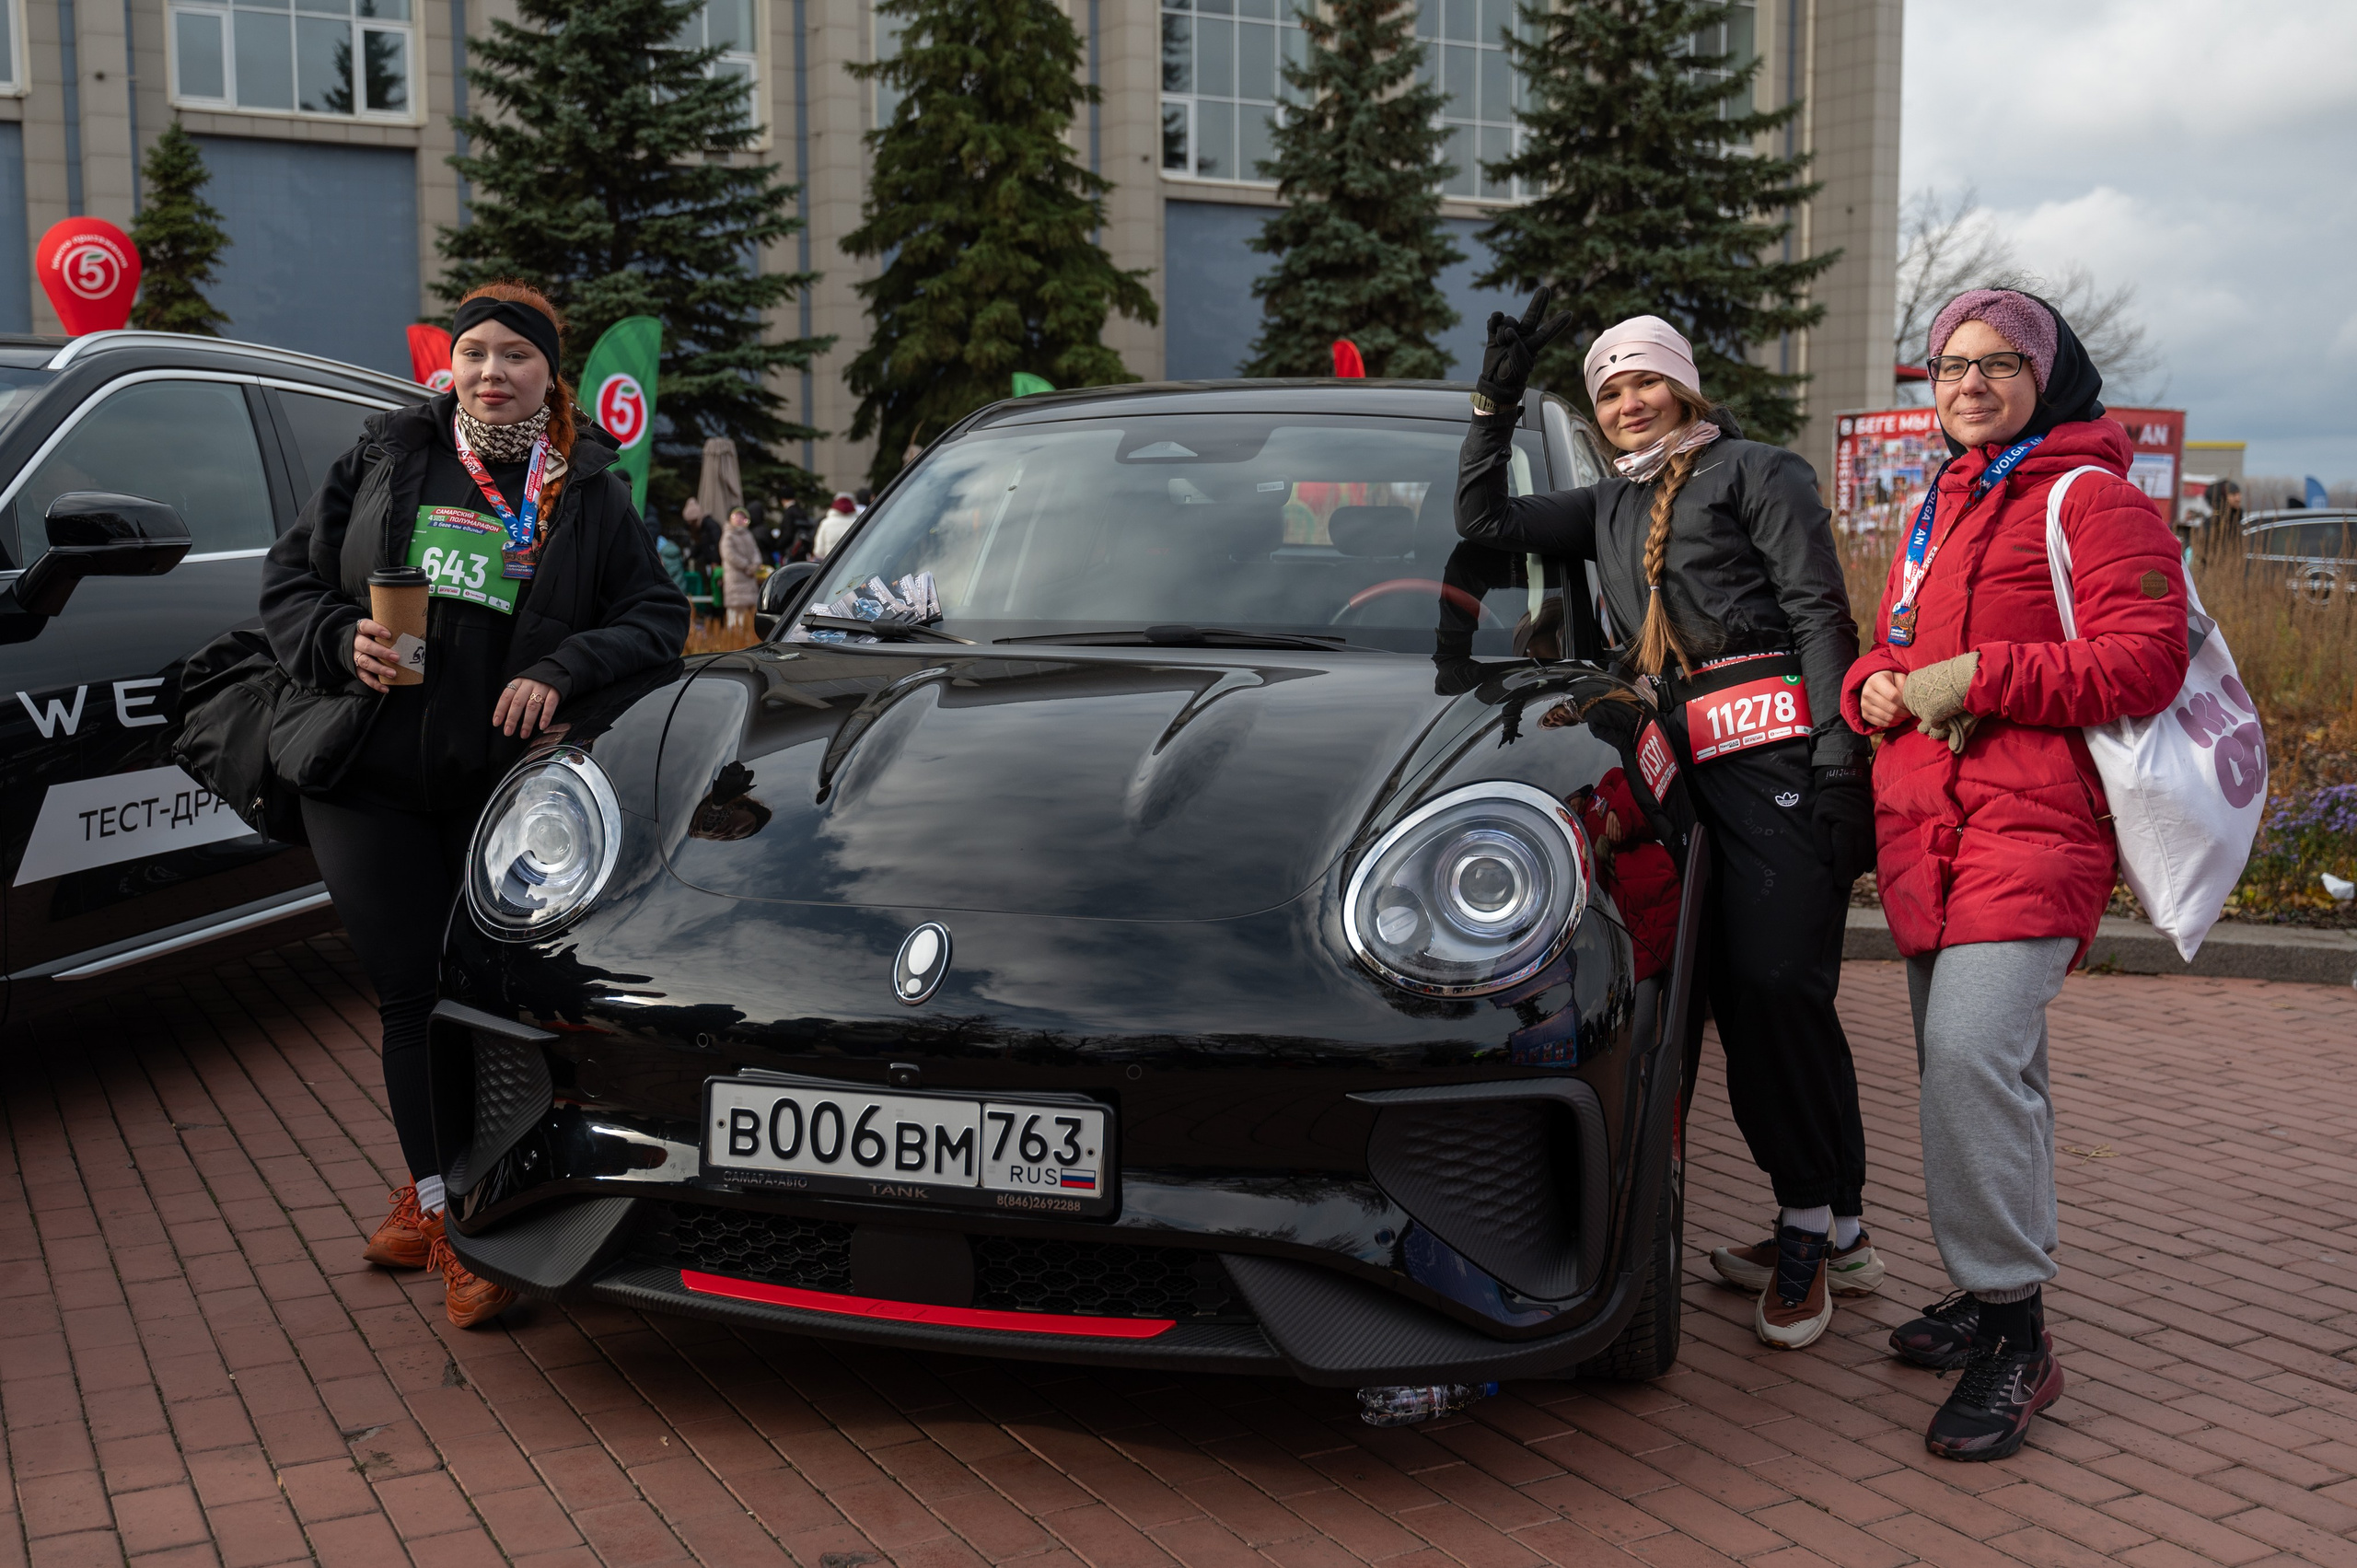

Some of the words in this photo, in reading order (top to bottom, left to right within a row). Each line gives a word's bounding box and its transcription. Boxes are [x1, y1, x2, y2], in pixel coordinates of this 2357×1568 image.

[78, 251, 108, 290] 5
[609, 382, 638, 435] 5
[1854, 416, 1898, 435] БЕГЕ
[1898, 413, 1932, 432] МЫ
[435, 508, 475, 519] САМАРСКИЙ
[449, 516, 499, 532] ПОЛУМАРАФОН
[422, 547, 489, 588] 643
[1706, 691, 1796, 740] 11278
[79, 789, 229, 842] ТЕСТ-ДРА
[728, 1098, 974, 1177] В006ВМ
[987, 1110, 1082, 1166] 763
[724, 1170, 808, 1188] САМАРА-АВТО
[1010, 1165, 1058, 1185] RUS
[867, 1183, 930, 1200] TANK
[996, 1194, 1082, 1213] 8(846)2692288
